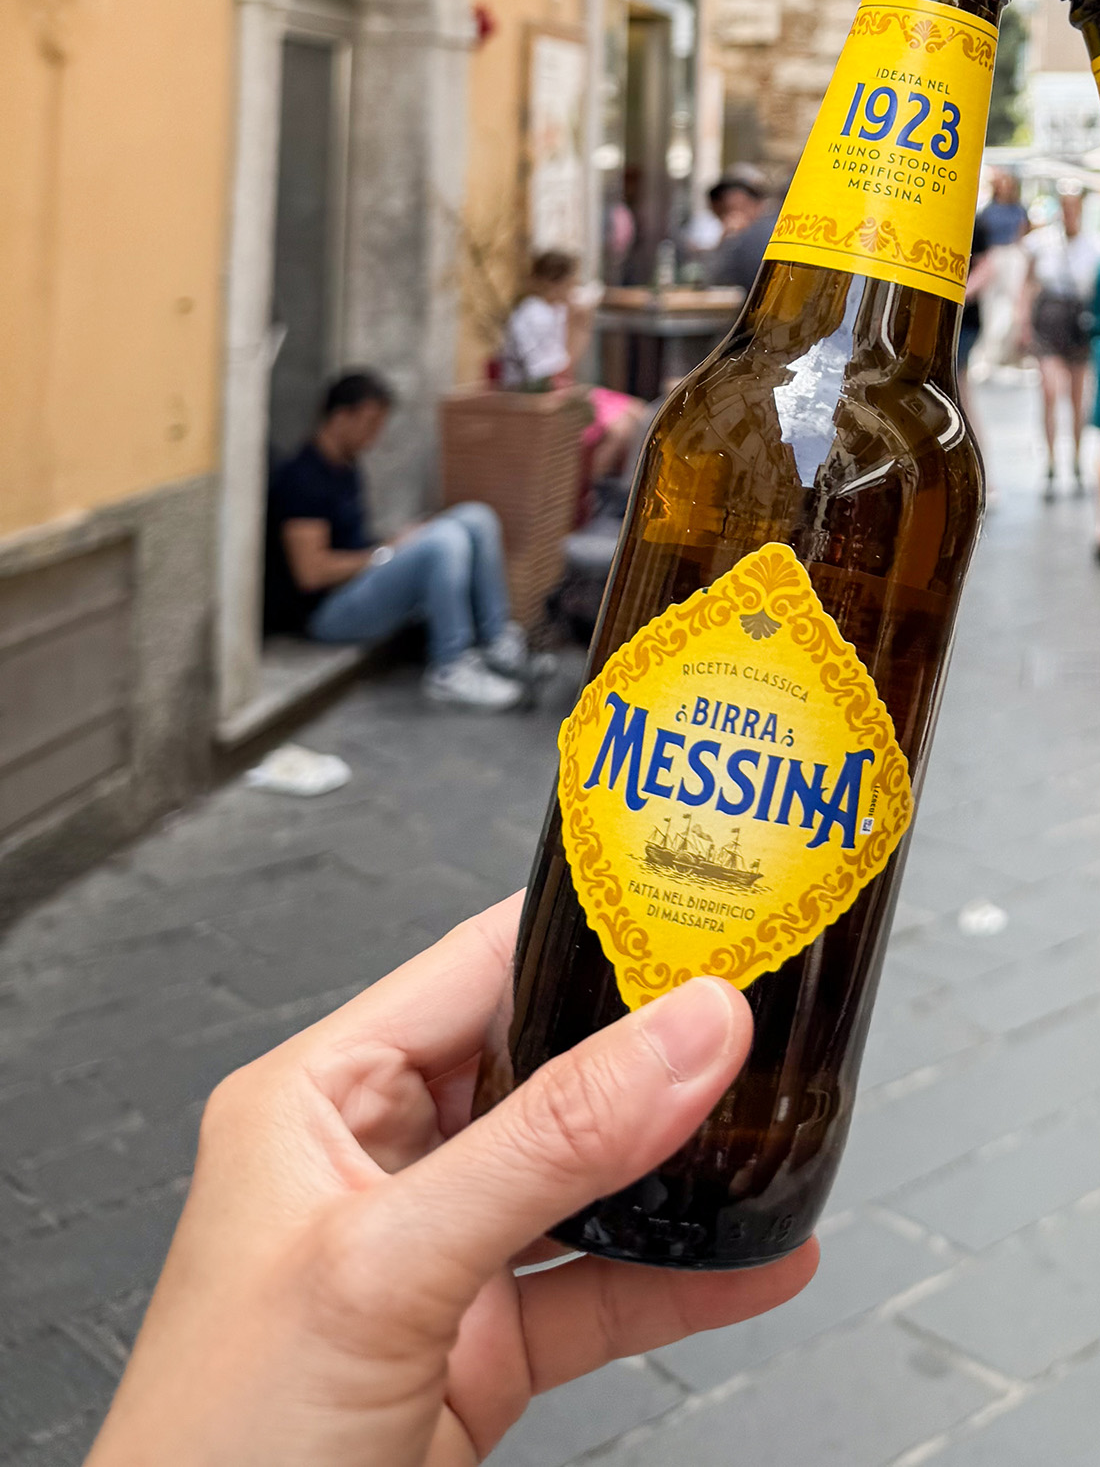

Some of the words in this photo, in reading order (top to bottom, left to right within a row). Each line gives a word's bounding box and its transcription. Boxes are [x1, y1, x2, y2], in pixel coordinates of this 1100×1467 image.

[876, 68, 922, 87] IDEATA
[928, 78, 951, 95] NEL
[840, 82, 961, 160] 1923
[828, 142, 842, 154] IN
[847, 146, 880, 160] UNO
[887, 153, 958, 182] STORICO
[832, 159, 926, 188] BIRRIFICIO
[932, 181, 946, 195] DI
[848, 179, 923, 204] MESSINA
[682, 662, 738, 677] RICETTA
[742, 666, 809, 703] CLASSICA
[691, 696, 778, 742] BIRRA
[584, 691, 874, 849] MESSINA
[628, 880, 660, 901] FATTA
[662, 890, 685, 906] NEL
[686, 895, 755, 921] BIRRIFICIO
[646, 904, 661, 918] DI
[662, 908, 725, 933] MASSAFRA
